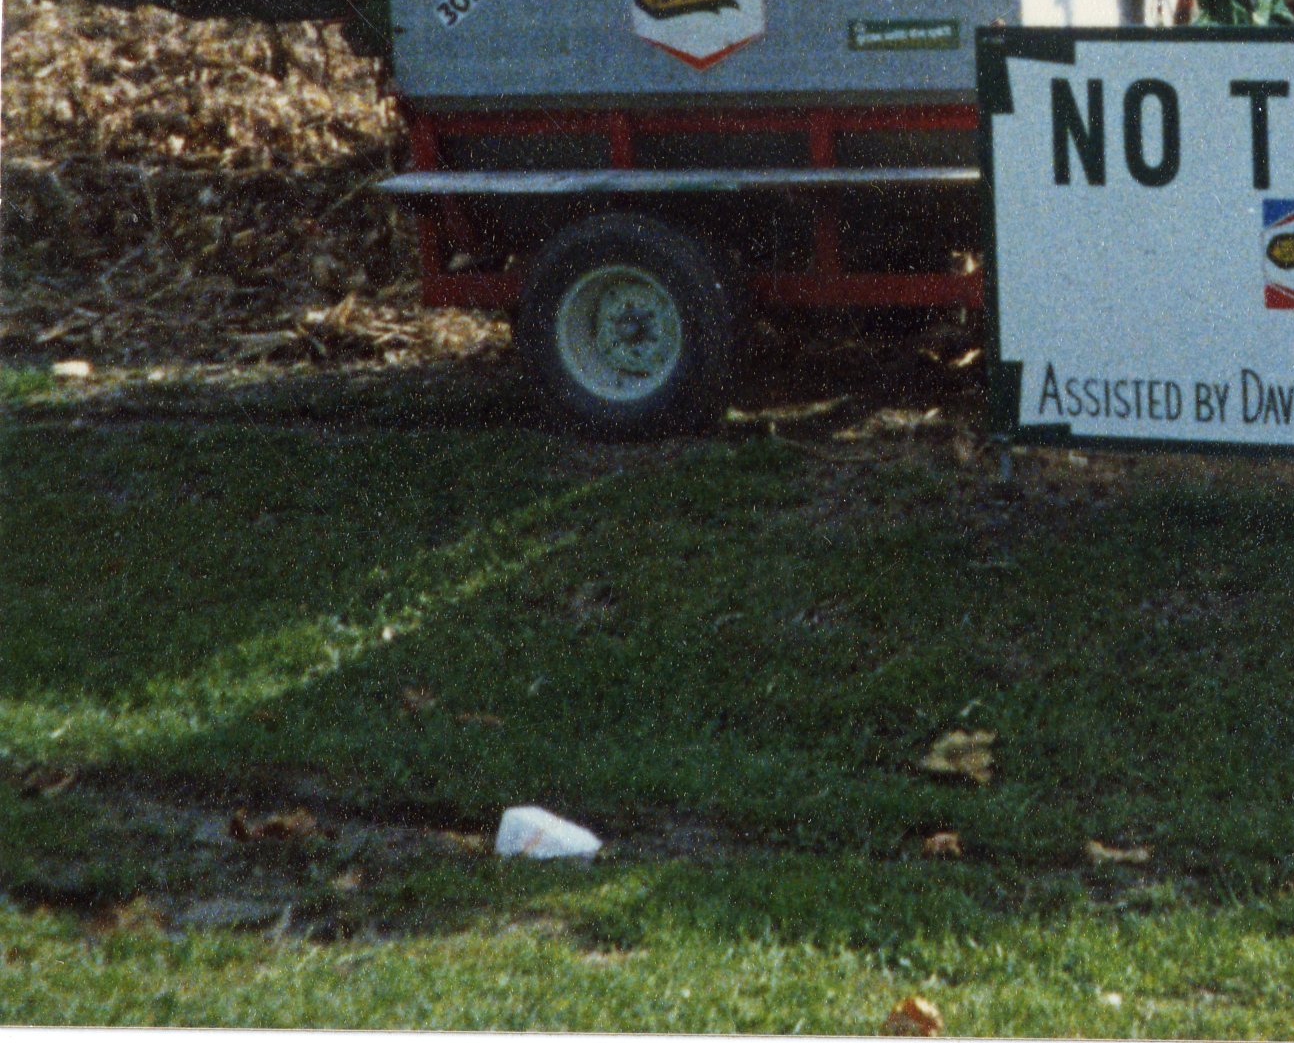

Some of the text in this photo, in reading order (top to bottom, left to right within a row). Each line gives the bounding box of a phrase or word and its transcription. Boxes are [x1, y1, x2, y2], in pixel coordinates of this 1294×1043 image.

[1050, 77, 1181, 188] NO
[1038, 361, 1182, 421] ASSISTED
[1194, 381, 1230, 423] BY
